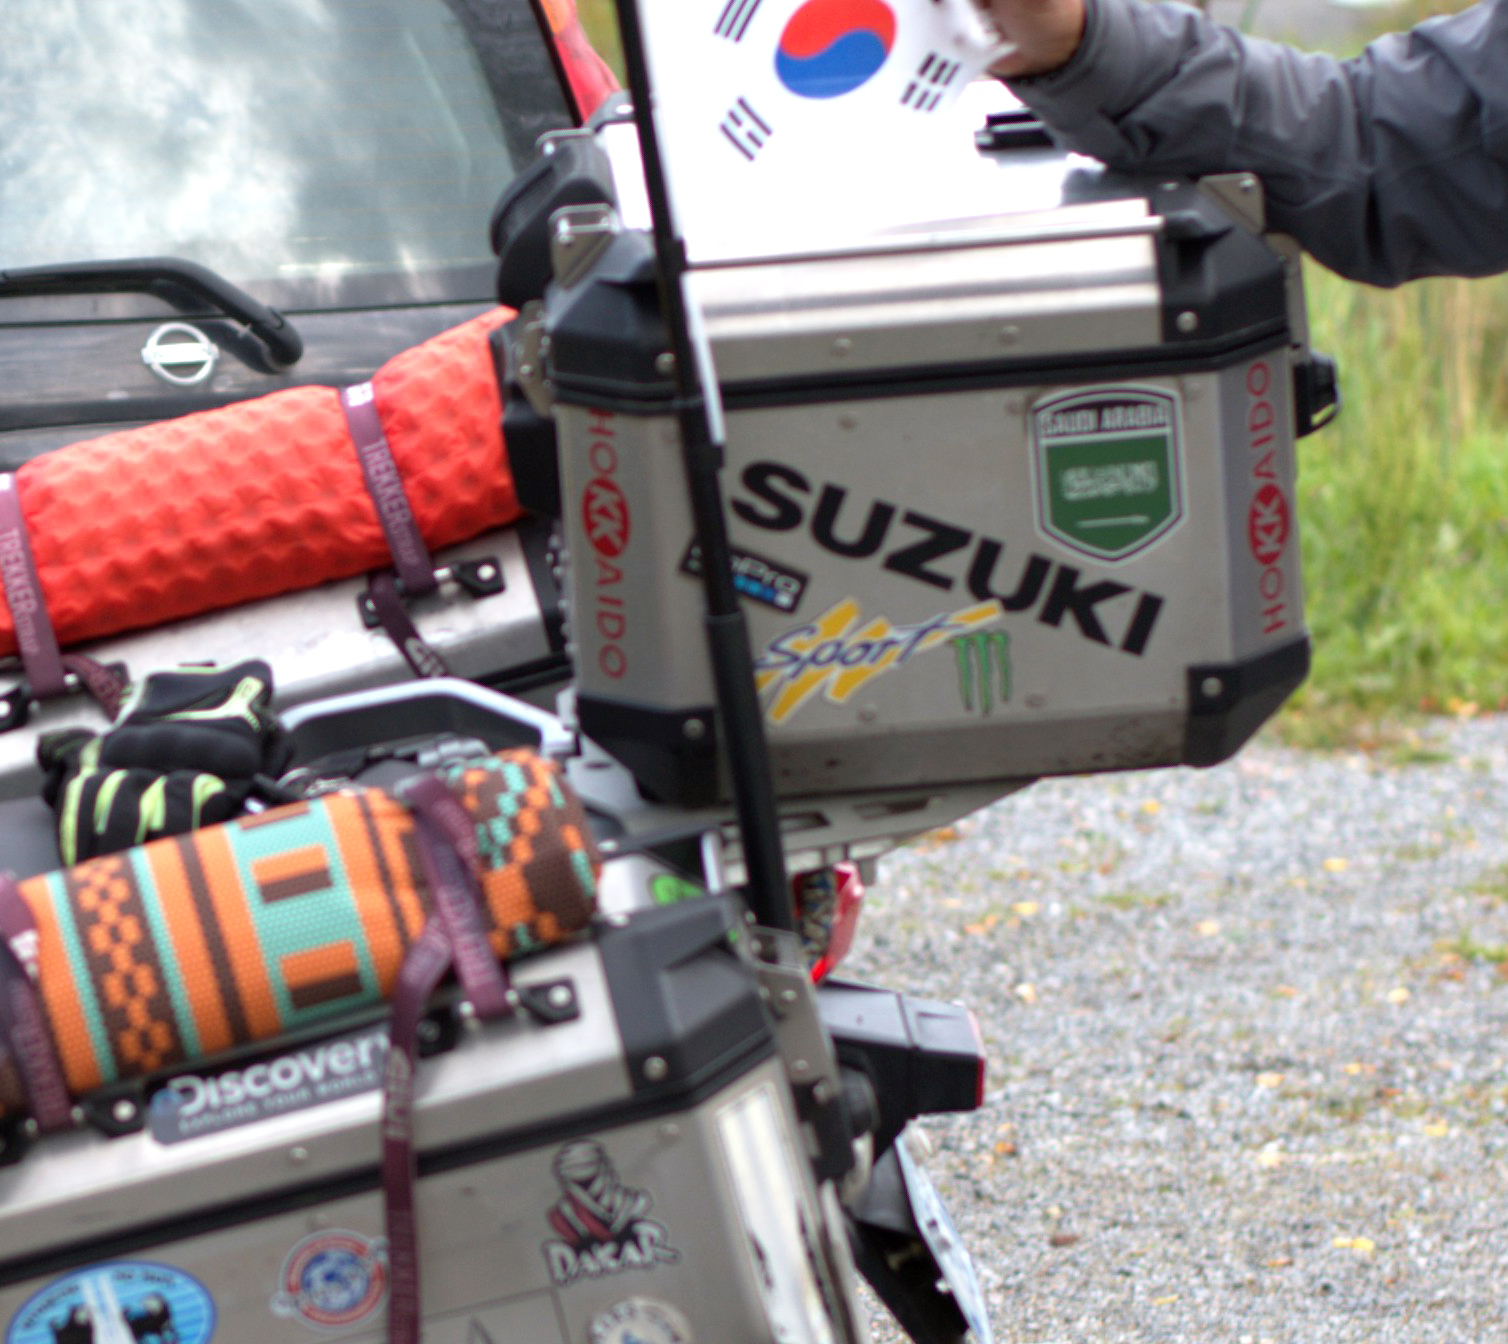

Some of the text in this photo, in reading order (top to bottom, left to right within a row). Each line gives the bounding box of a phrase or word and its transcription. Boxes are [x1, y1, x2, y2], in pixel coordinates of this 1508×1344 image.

[583, 408, 629, 680] HOKKAIDO
[730, 461, 1165, 657] SUZUKI
[1246, 361, 1288, 634] HOKKAIDO
[548, 1220, 678, 1285] DAKAR
